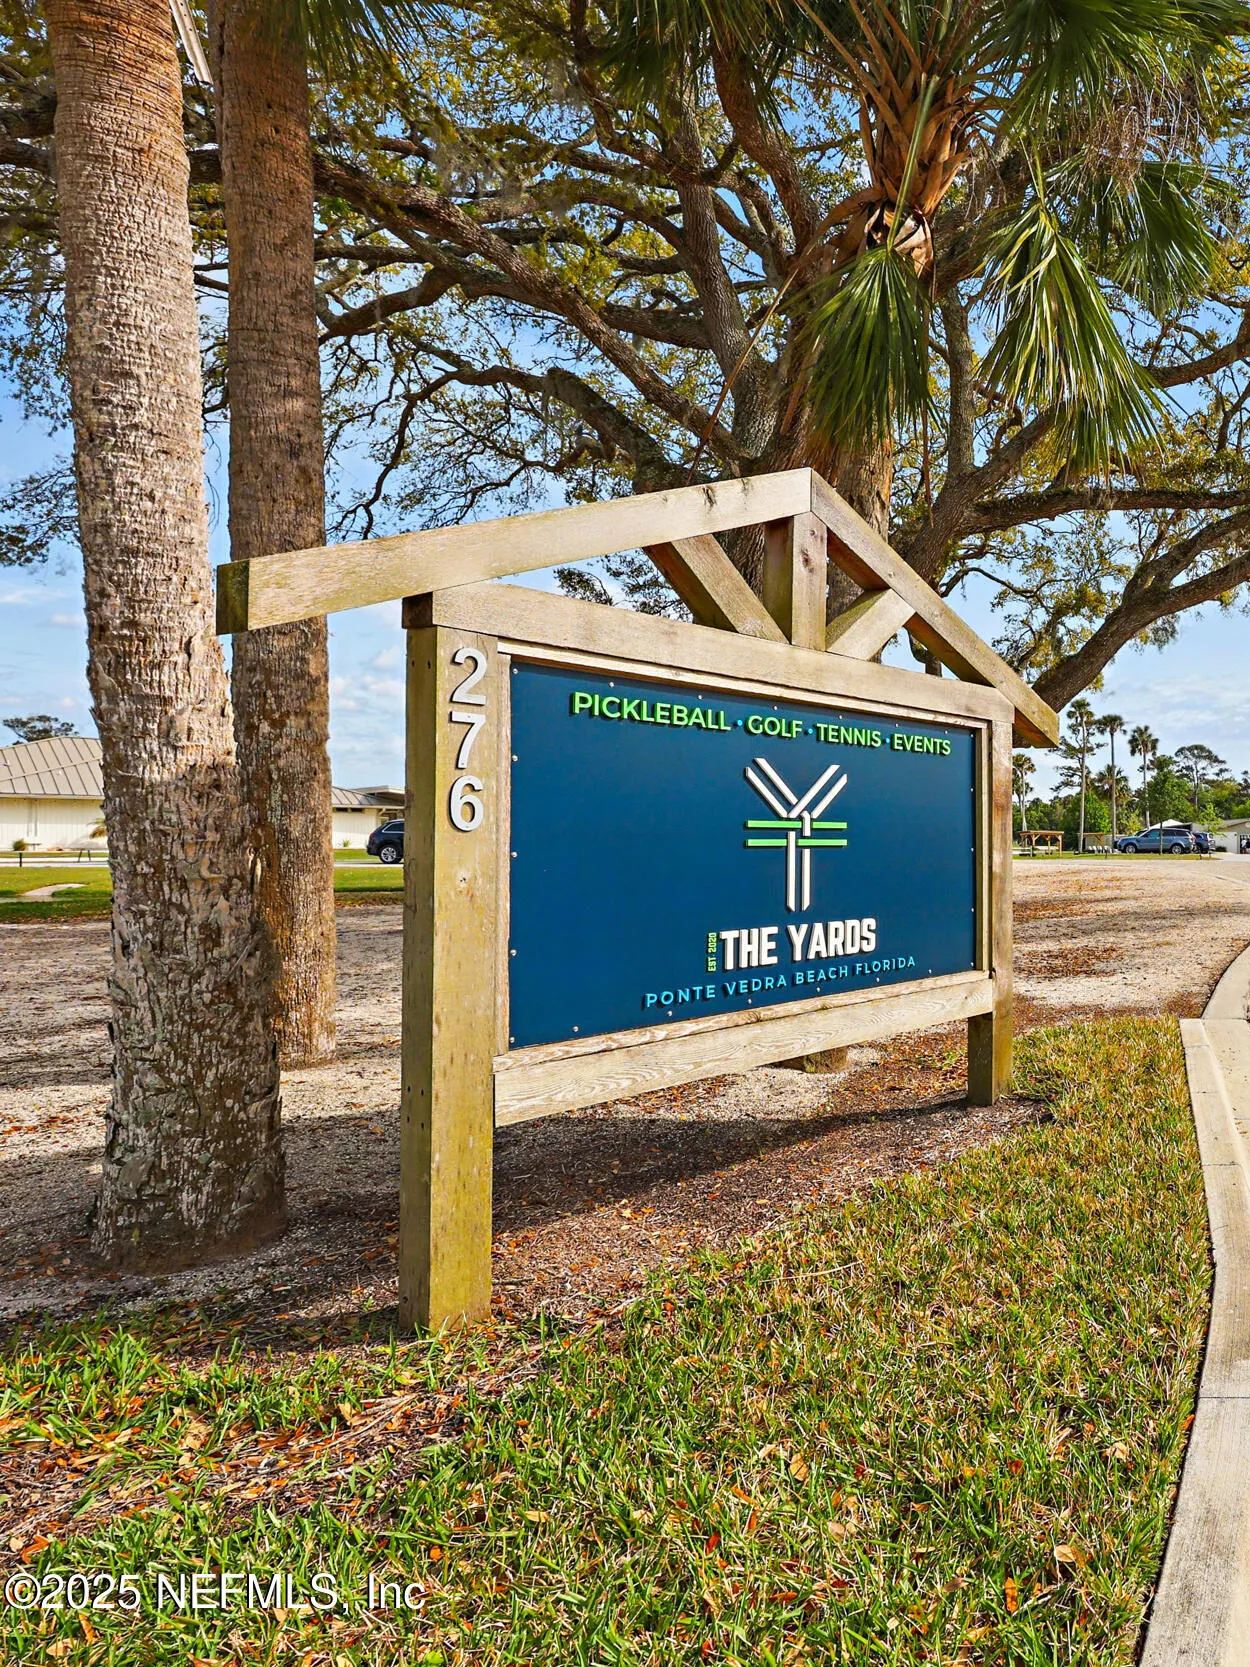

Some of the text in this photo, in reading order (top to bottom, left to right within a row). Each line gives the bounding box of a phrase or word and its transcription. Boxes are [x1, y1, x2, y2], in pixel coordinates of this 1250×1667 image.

[449, 647, 488, 832] 276
[572, 691, 951, 756] PICKLEBALL GOLF TENNIS EVENTS
[707, 932, 717, 953] 2020
[719, 917, 877, 971] THE YARDS
[646, 956, 917, 1008] PONTE VEDRA BEACH FLORIDA
